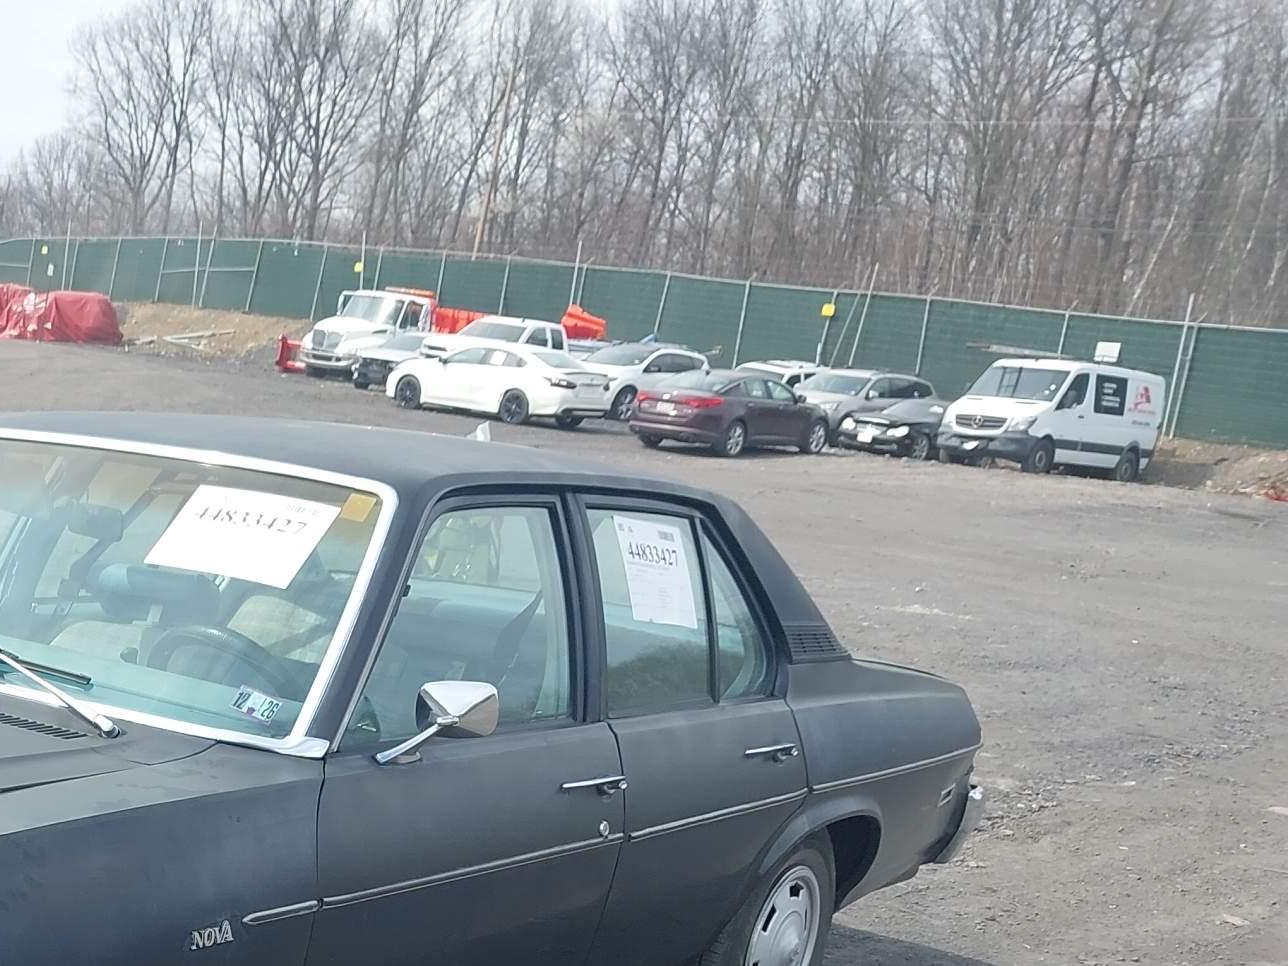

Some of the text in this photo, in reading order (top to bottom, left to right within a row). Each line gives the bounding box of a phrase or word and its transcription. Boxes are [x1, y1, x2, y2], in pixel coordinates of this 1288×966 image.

[195, 506, 308, 535] 44833427
[628, 541, 678, 567] 44833427
[233, 691, 280, 720] 12 26
[190, 919, 234, 950] NOVA
